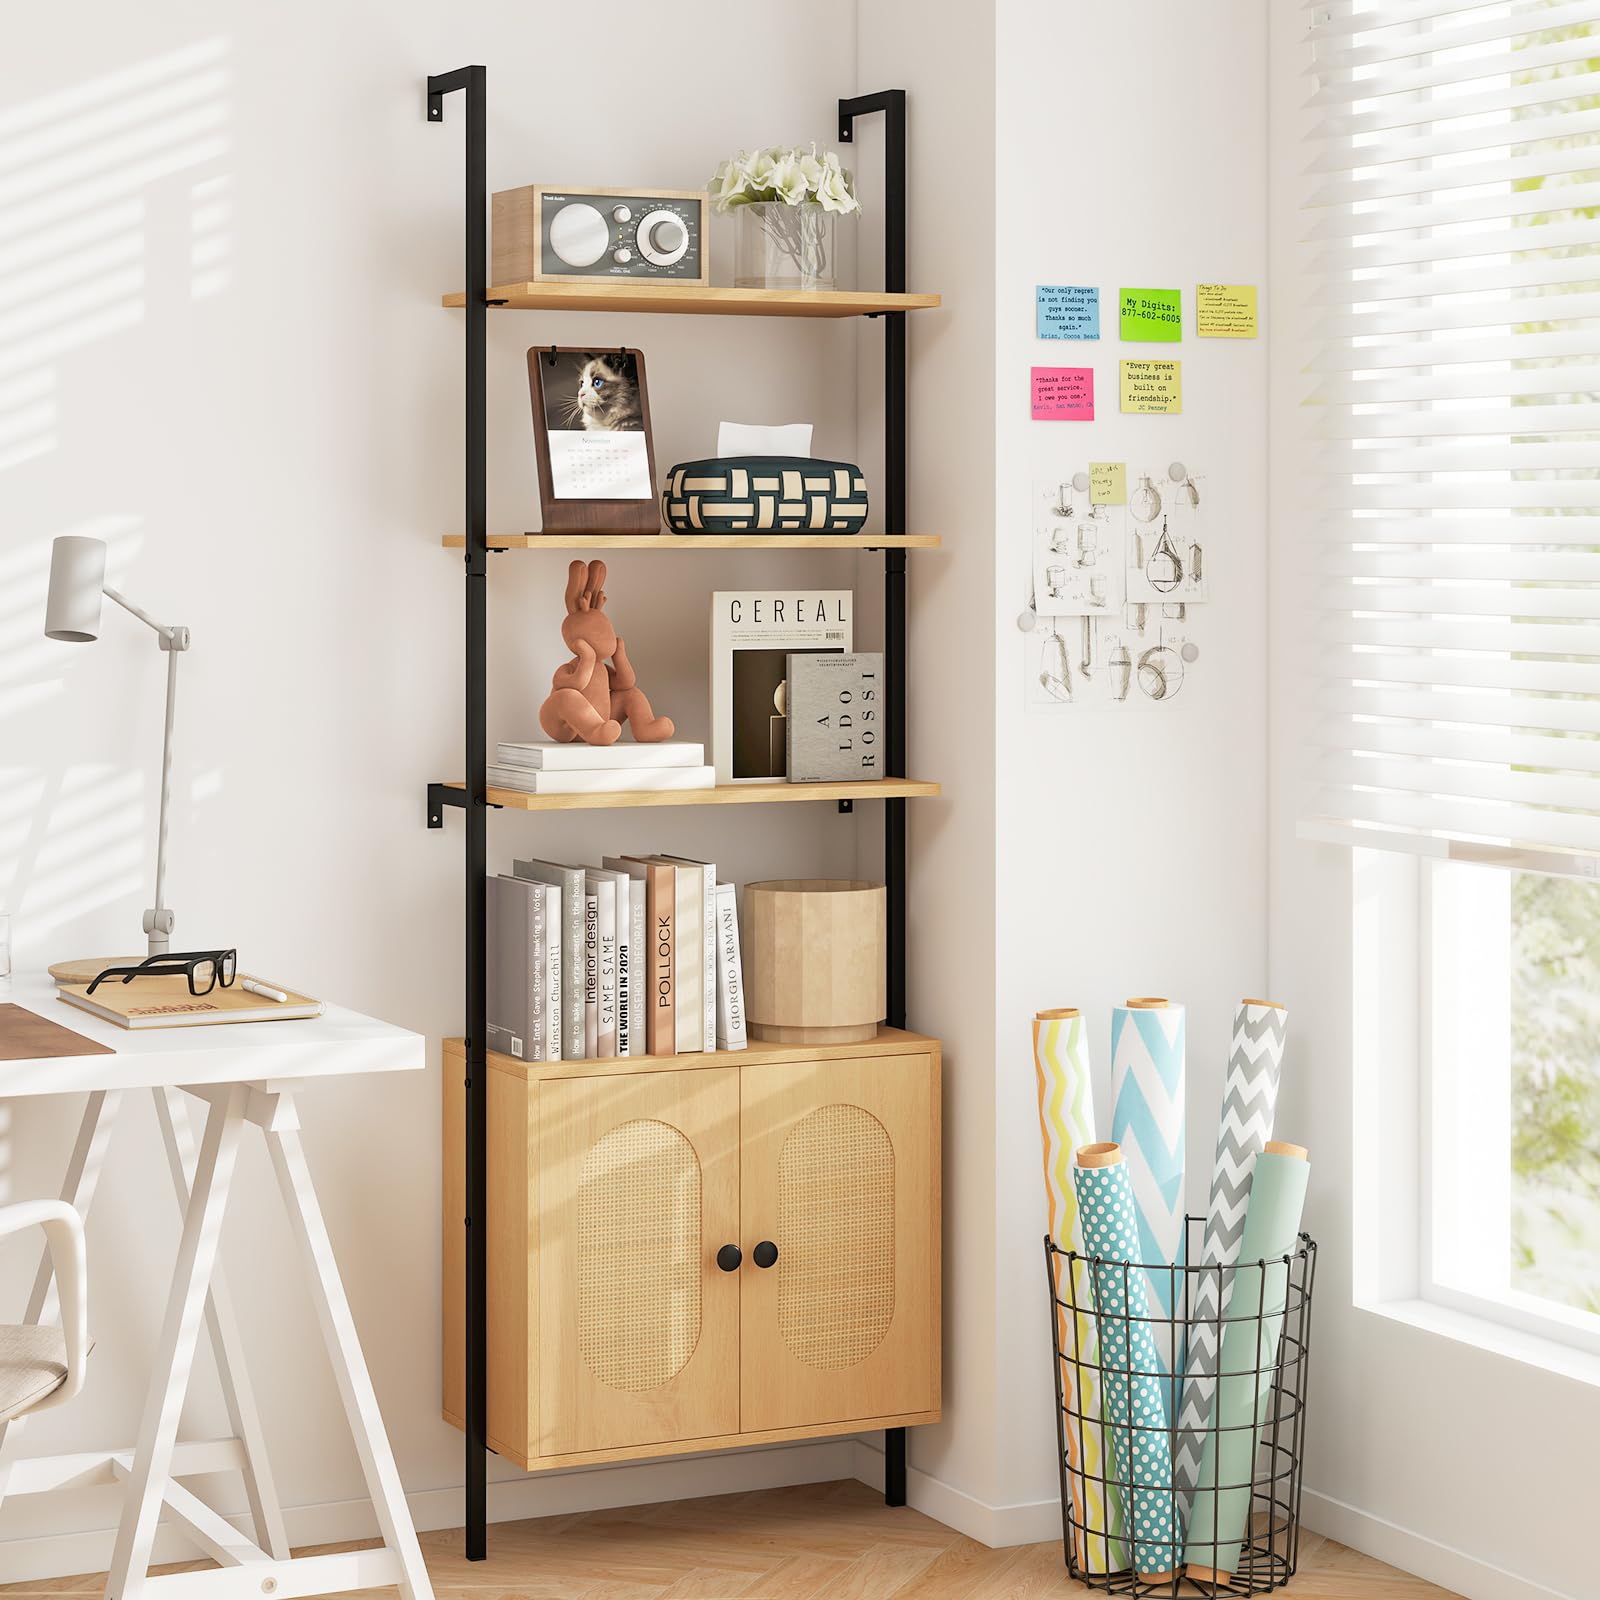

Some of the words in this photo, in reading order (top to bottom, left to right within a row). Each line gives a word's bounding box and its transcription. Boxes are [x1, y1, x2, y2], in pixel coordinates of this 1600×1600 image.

[1057, 287, 1072, 295] only
[1061, 296, 1085, 304] finding
[1121, 307, 1181, 323] 877-602-6005
[1126, 297, 1137, 309] My
[1141, 299, 1176, 312] Digits:
[1127, 372, 1161, 381] business
[1164, 373, 1173, 381] is
[1153, 363, 1175, 371] great
[1133, 383, 1155, 391] built
[730, 599, 847, 624] CEREAL
[861, 671, 875, 768] ROSSI
[572, 873, 580, 898] house
[533, 888, 541, 912] Voice
[572, 901, 580, 916] the
[585, 900, 598, 949] design
[634, 903, 644, 965] DECORATES
[723, 908, 736, 964] ARMANI
[533, 924, 542, 957] Hawking
[573, 934, 581, 985] arrangement
[602, 935, 614, 975] SAME
[619, 945, 629, 974] 2020
[658, 915, 671, 1008] POLLOCK
[533, 960, 542, 993] Stephen
[551, 944, 560, 1002] Churchill
[585, 955, 597, 1004] Interior
[619, 978, 629, 989] IN
[533, 996, 541, 1015] Gave
[573, 988, 580, 999] an
[602, 984, 614, 1024] SAME
[634, 969, 644, 1030] HOUSEHOLD
[729, 968, 741, 1031] GIORGIO
[572, 1002, 580, 1022] make
[619, 990, 629, 1031] WORLD
[533, 1019, 541, 1041] Intel
[551, 1008, 560, 1056] Winston
[572, 1026, 580, 1035] to
[619, 1031, 629, 1053] THE
[533, 1045, 541, 1060] How
[572, 1039, 580, 1055] How
